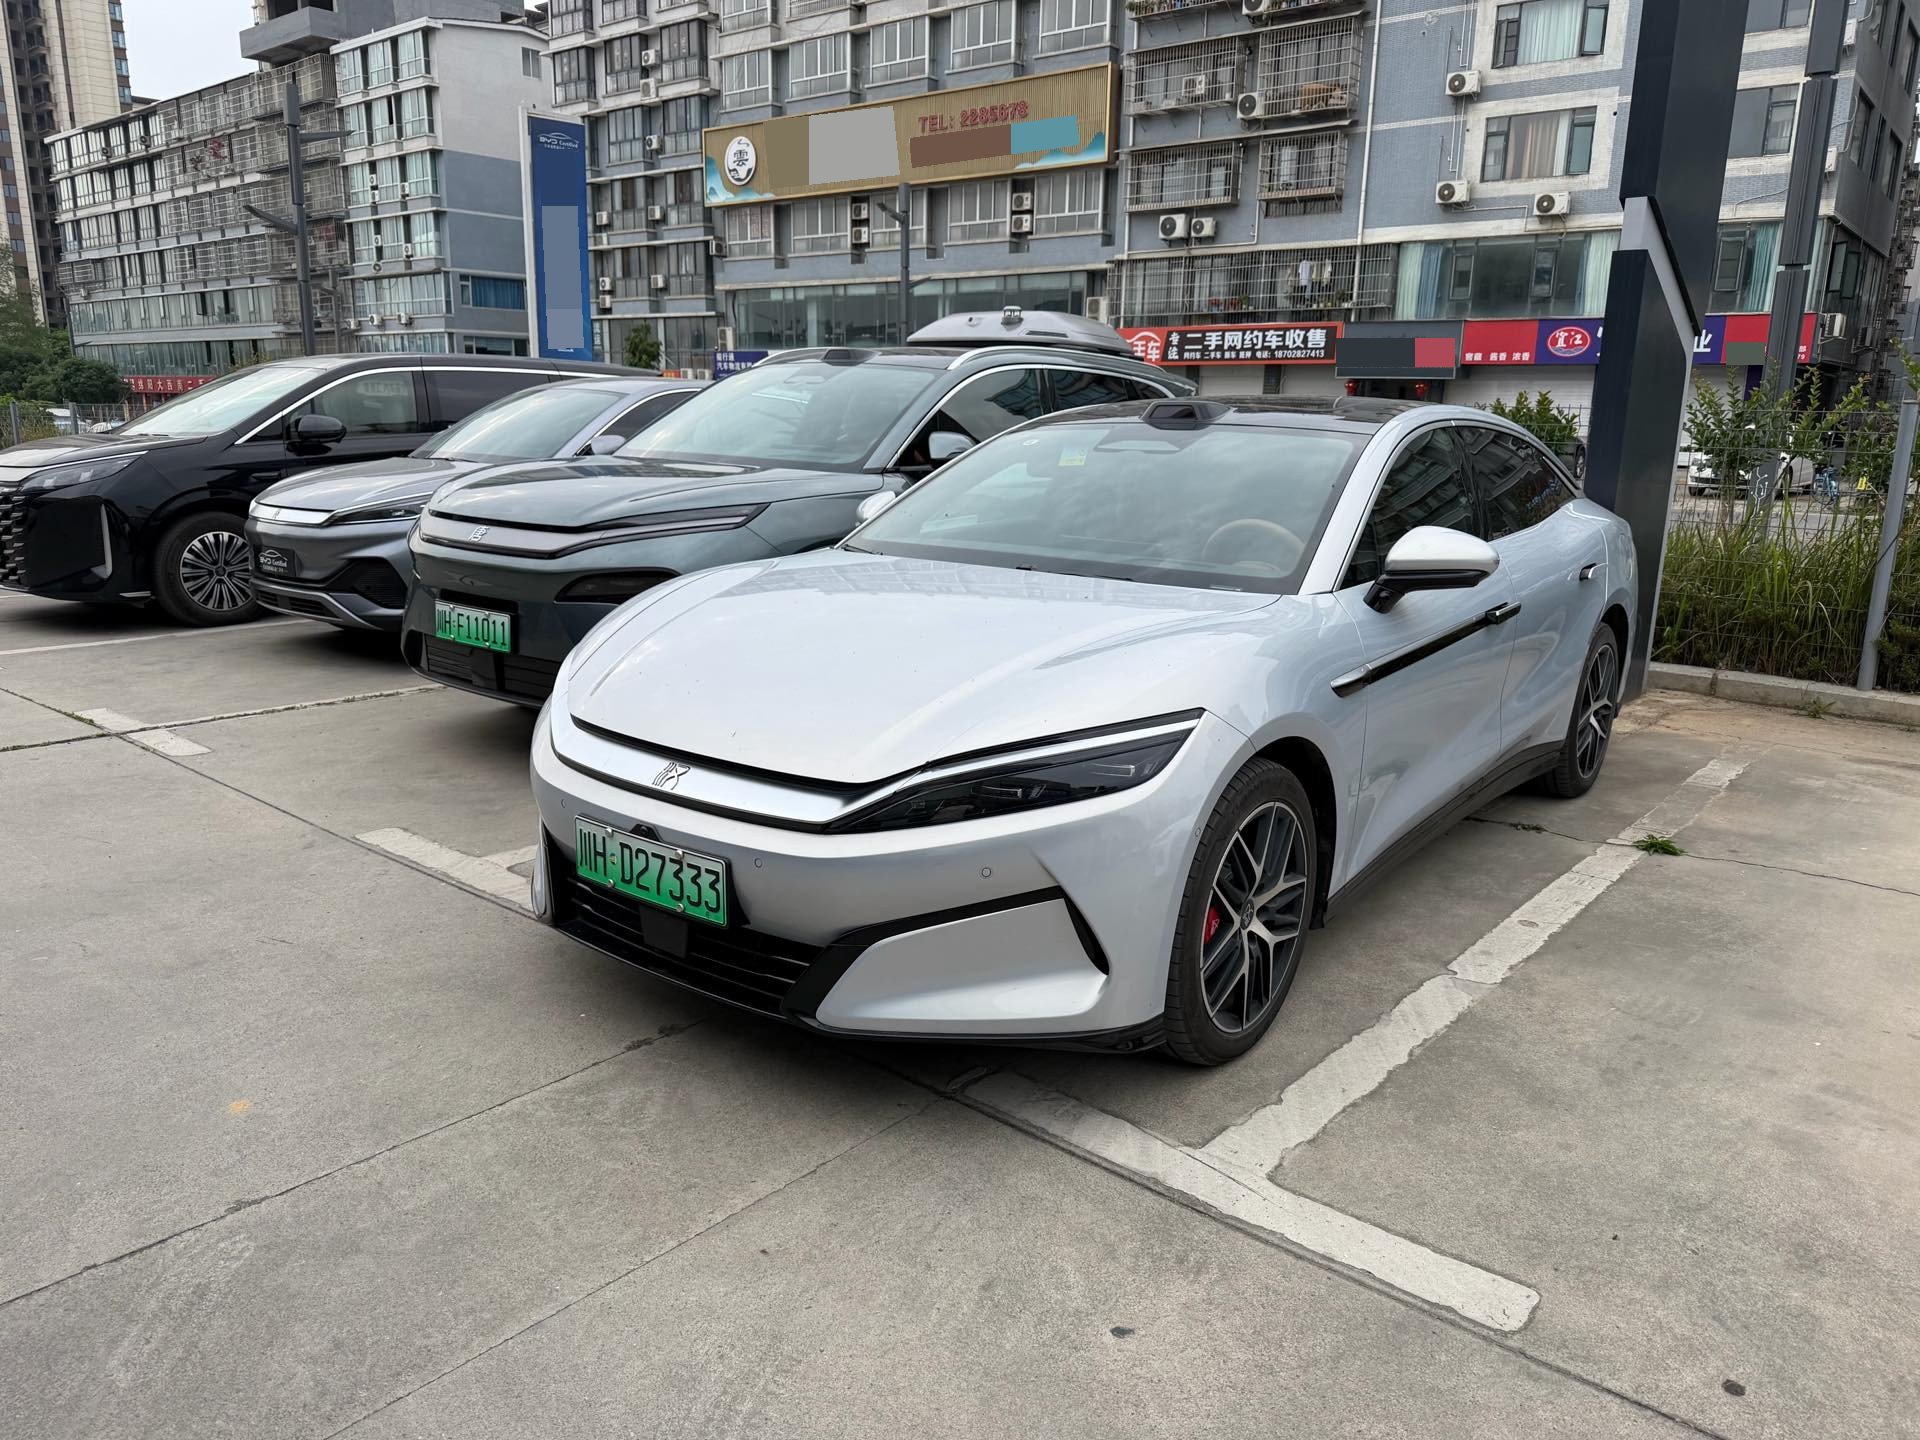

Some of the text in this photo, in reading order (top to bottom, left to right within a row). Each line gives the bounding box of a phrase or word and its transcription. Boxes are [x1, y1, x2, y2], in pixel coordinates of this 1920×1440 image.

[918, 100, 1029, 133] TEL: 2285678
[1167, 331, 1180, 360] 专注
[1184, 328, 1327, 351] 二手网约车收售
[1274, 349, 1325, 359] 18702827413
